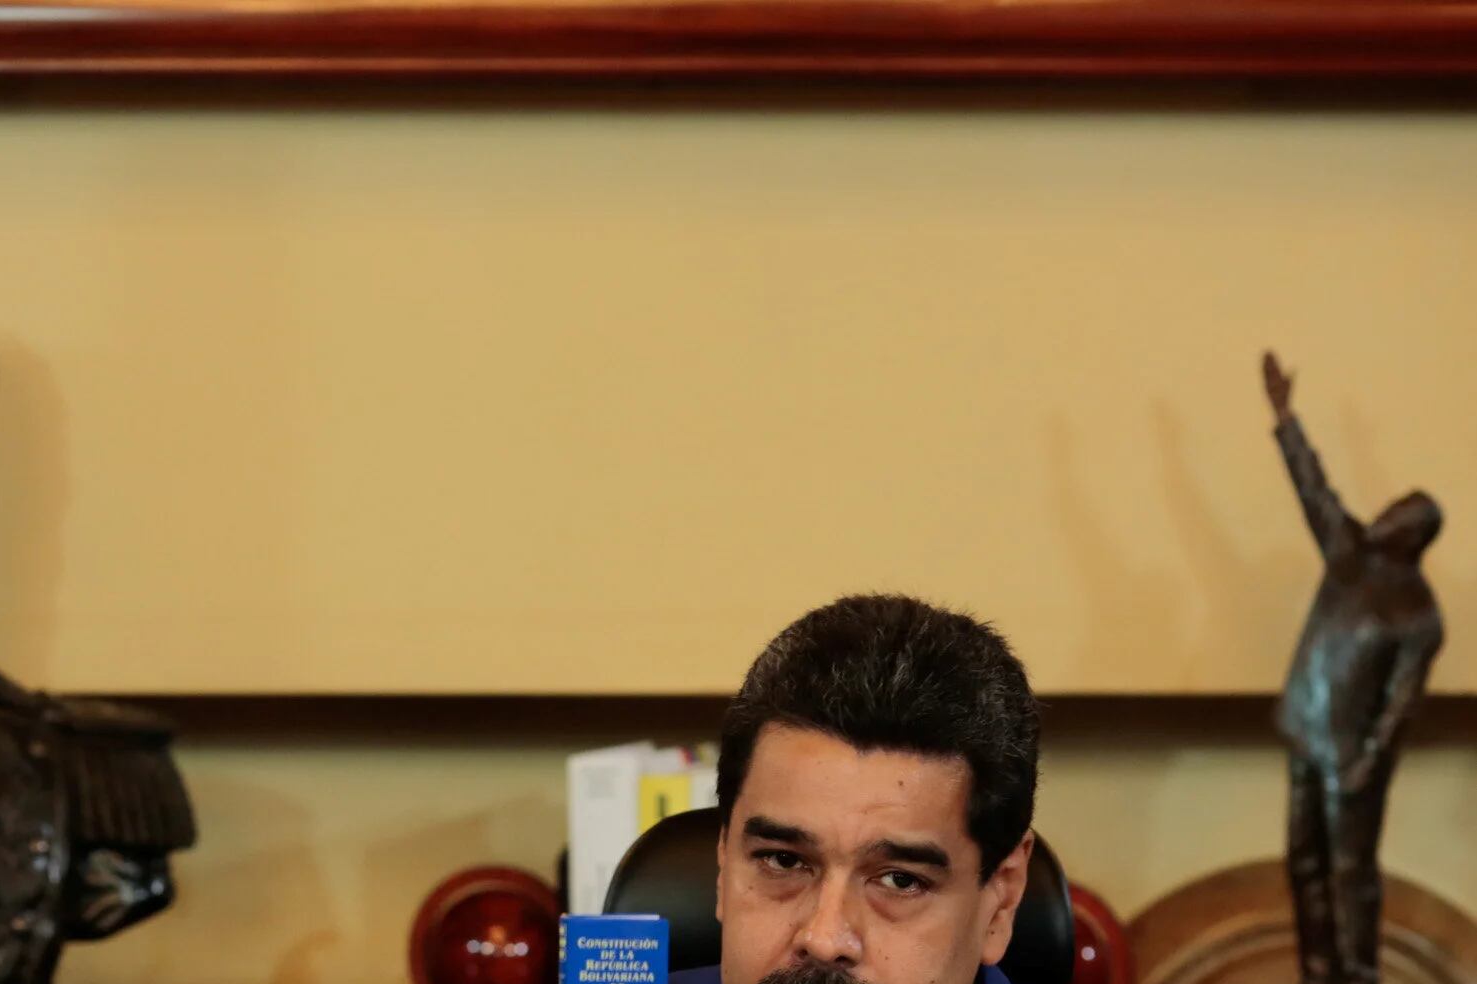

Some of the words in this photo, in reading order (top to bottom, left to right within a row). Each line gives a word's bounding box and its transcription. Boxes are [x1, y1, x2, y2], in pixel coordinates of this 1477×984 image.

[576, 936, 658, 949] CONSTITUCIÓN
[600, 950, 615, 960] DE
[619, 950, 635, 960] LA
[579, 971, 655, 982] BOLIVARIANA
